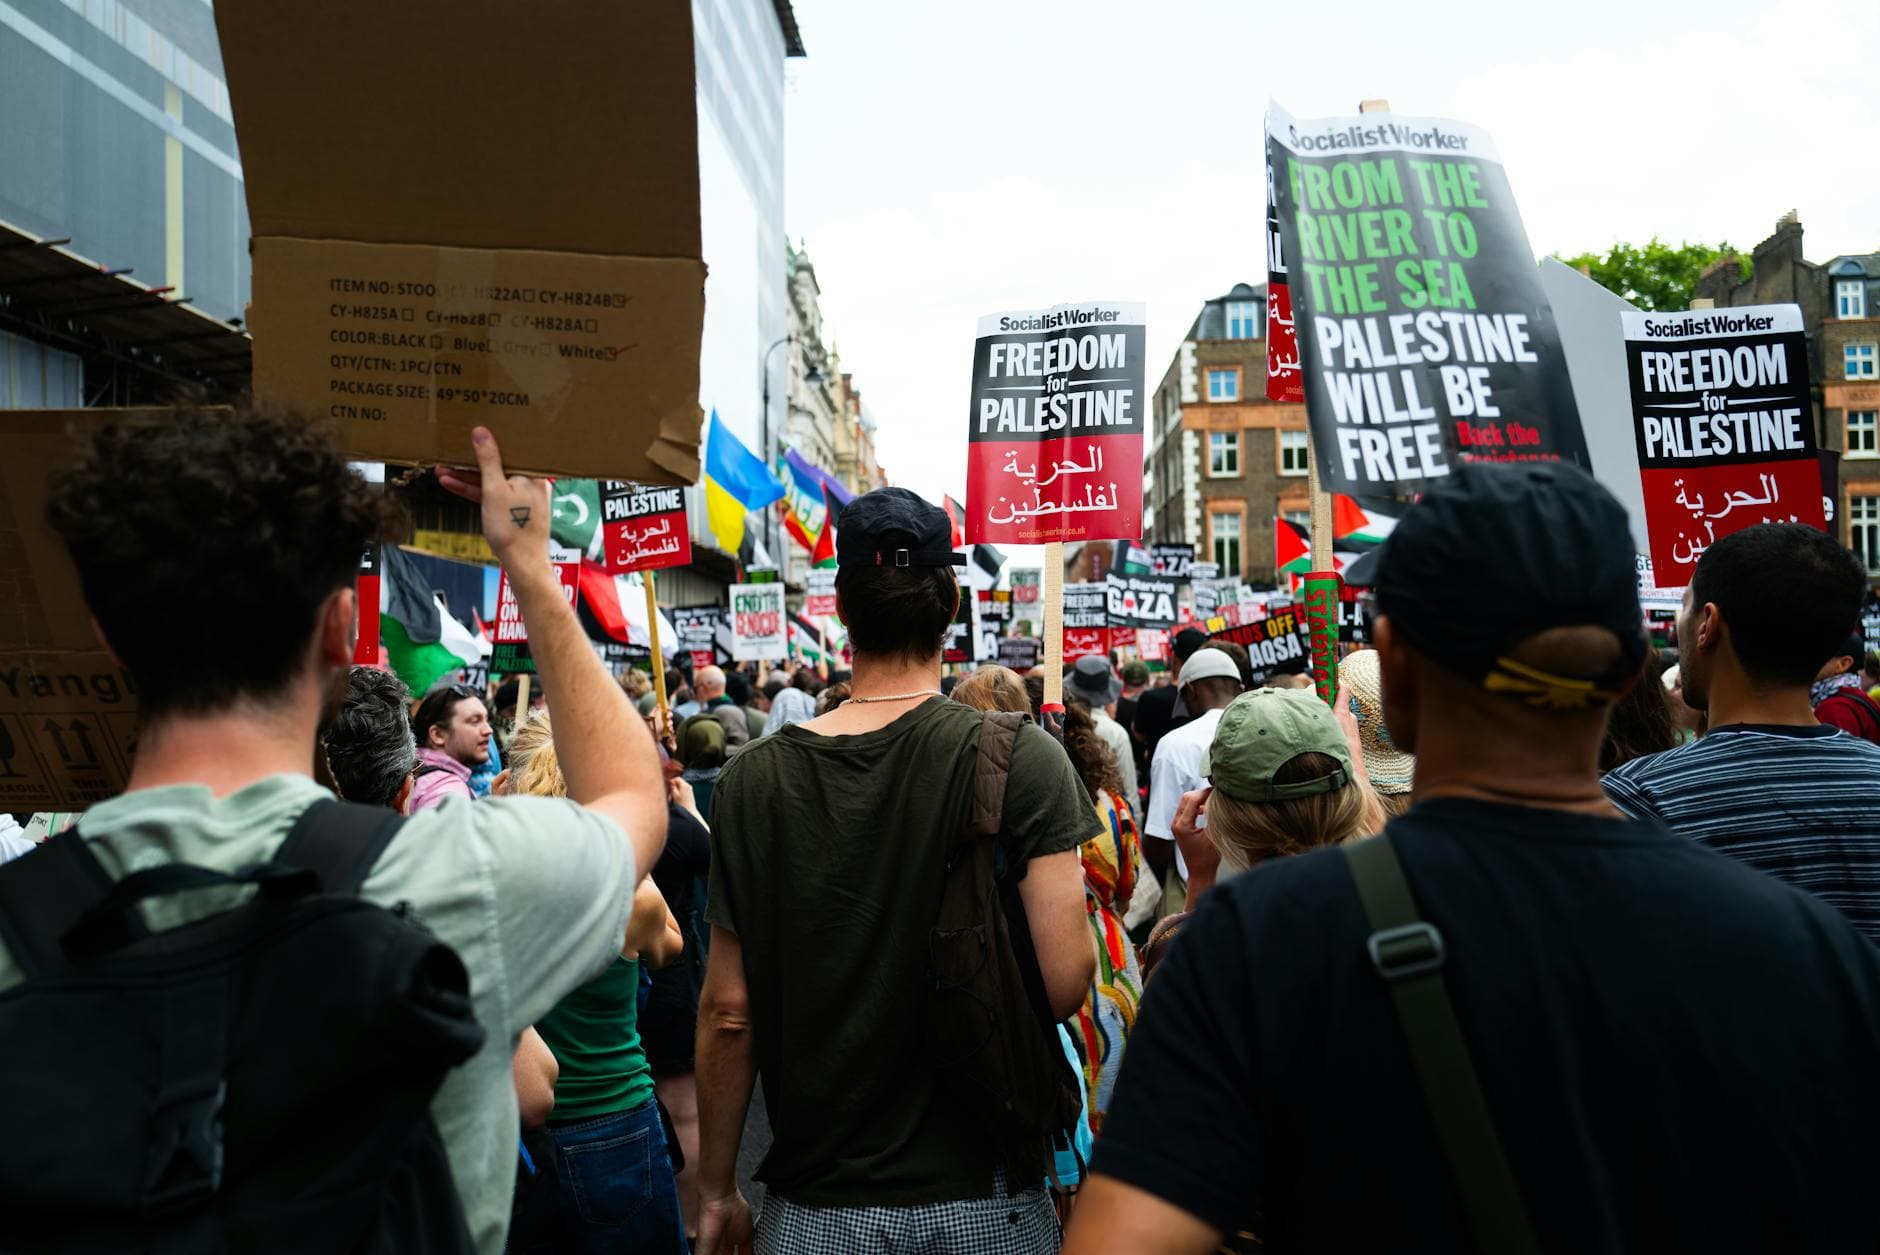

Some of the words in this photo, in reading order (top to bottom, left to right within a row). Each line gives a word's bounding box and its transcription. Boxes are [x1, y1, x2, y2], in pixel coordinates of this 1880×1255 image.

[1288, 157, 1404, 211] FROM
[1409, 160, 1488, 209] THE
[1295, 208, 1417, 261] RIVER
[1422, 209, 1478, 259] TO
[330, 279, 365, 292] ITEM
[369, 281, 395, 295] NO:
[539, 290, 614, 307] CY-H824B
[1303, 263, 1394, 314] THE
[1395, 259, 1477, 310] SEA
[330, 304, 398, 320] CY-H825A
[454, 337, 487, 353] Blue
[559, 343, 605, 360] White
[989, 333, 1126, 378] FREEDOM
[1314, 311, 1538, 368] PALESTINE
[330, 355, 397, 372] QTY/CTN:
[399, 359, 462, 376] 1PC/CTN
[1641, 343, 1788, 392] FREEDOM
[330, 380, 393, 397] PACKAGE
[396, 384, 430, 399] SIZE:
[1047, 375, 1068, 394] for
[1323, 370, 1436, 424] WILL
[1440, 365, 1500, 418] BE
[1701, 391, 1728, 411] for
[330, 405, 357, 418] CTN
[361, 406, 387, 420] NO:
[979, 389, 1133, 433] PALESTINE
[1456, 421, 1504, 446] Back
[1506, 422, 1541, 446] the
[1643, 408, 1805, 458] PALESTINE
[1003, 444, 1103, 486] الحرية
[1336, 423, 1450, 482] FREE
[605, 488, 681, 520] PALESTINE
[988, 482, 1118, 524] لفلسطين
[1675, 473, 1780, 520] الحرية
[620, 518, 670, 544] الحرية
[616, 536, 680, 566] لفلسطين
[500, 603, 519, 621] ON
[1107, 587, 1175, 621] GAZA
[1266, 614, 1295, 638] OFF
[1248, 632, 1303, 669] AQSA
